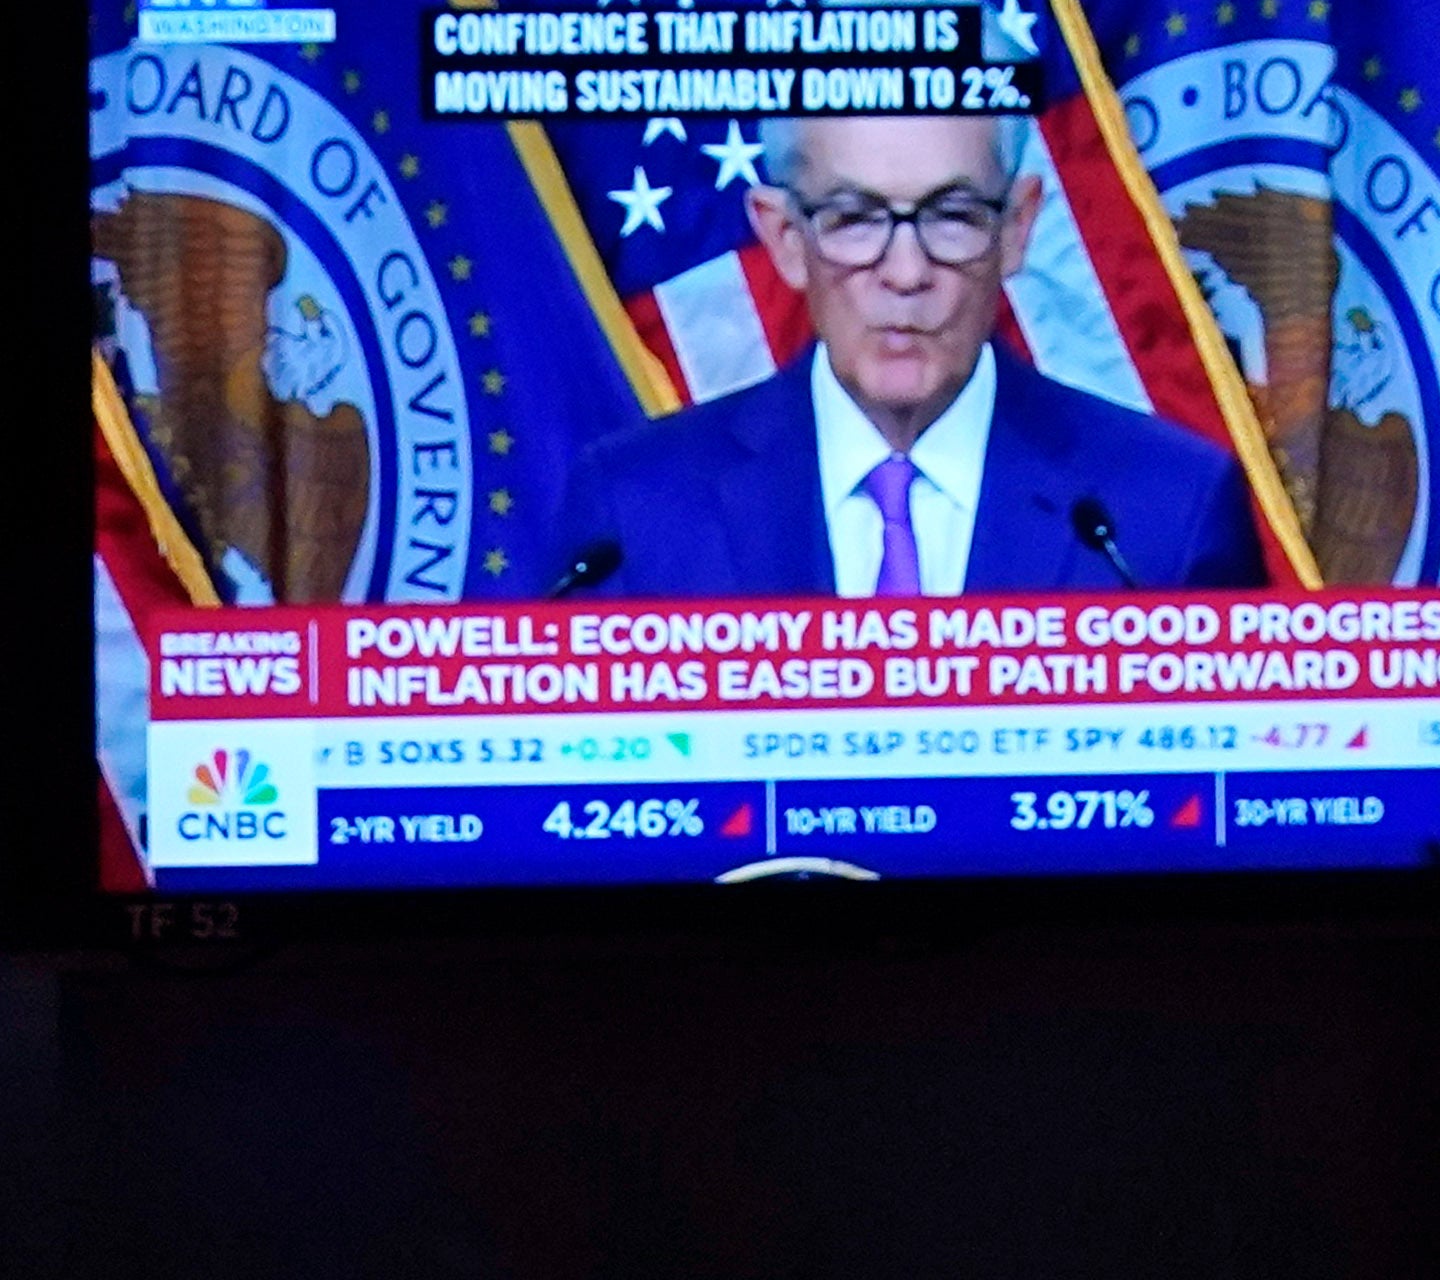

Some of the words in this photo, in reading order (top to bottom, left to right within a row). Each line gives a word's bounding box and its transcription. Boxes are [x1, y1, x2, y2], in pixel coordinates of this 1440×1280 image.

[435, 12, 648, 55] CONFIDENCE
[655, 11, 737, 54] THAT
[745, 11, 916, 51] INFLATION
[925, 9, 959, 50] IS
[435, 72, 567, 112] MOVING
[576, 68, 794, 110] SUSTAINABLY
[802, 68, 901, 108] DOWN
[910, 67, 951, 107] TO
[961, 67, 1031, 108] 2%.
[178, 812, 287, 839] CNBC
